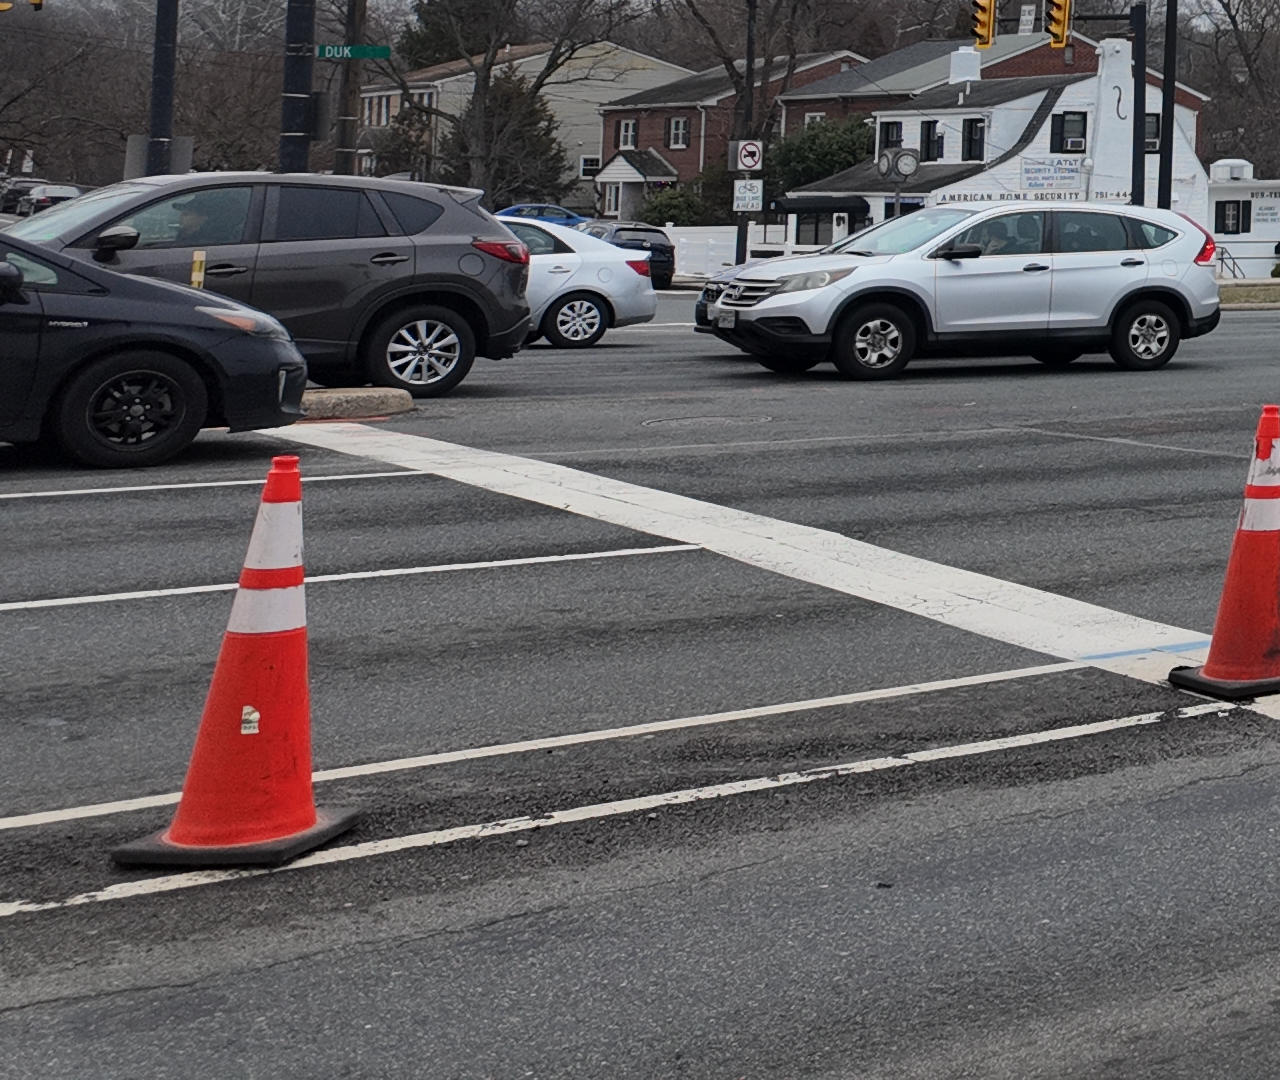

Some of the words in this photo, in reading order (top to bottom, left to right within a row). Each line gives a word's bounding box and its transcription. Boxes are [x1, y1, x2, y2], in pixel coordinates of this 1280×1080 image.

[941, 193, 993, 202] AMERICAN
[999, 193, 1028, 201] HOME
[1034, 192, 1080, 201] SECURITY
